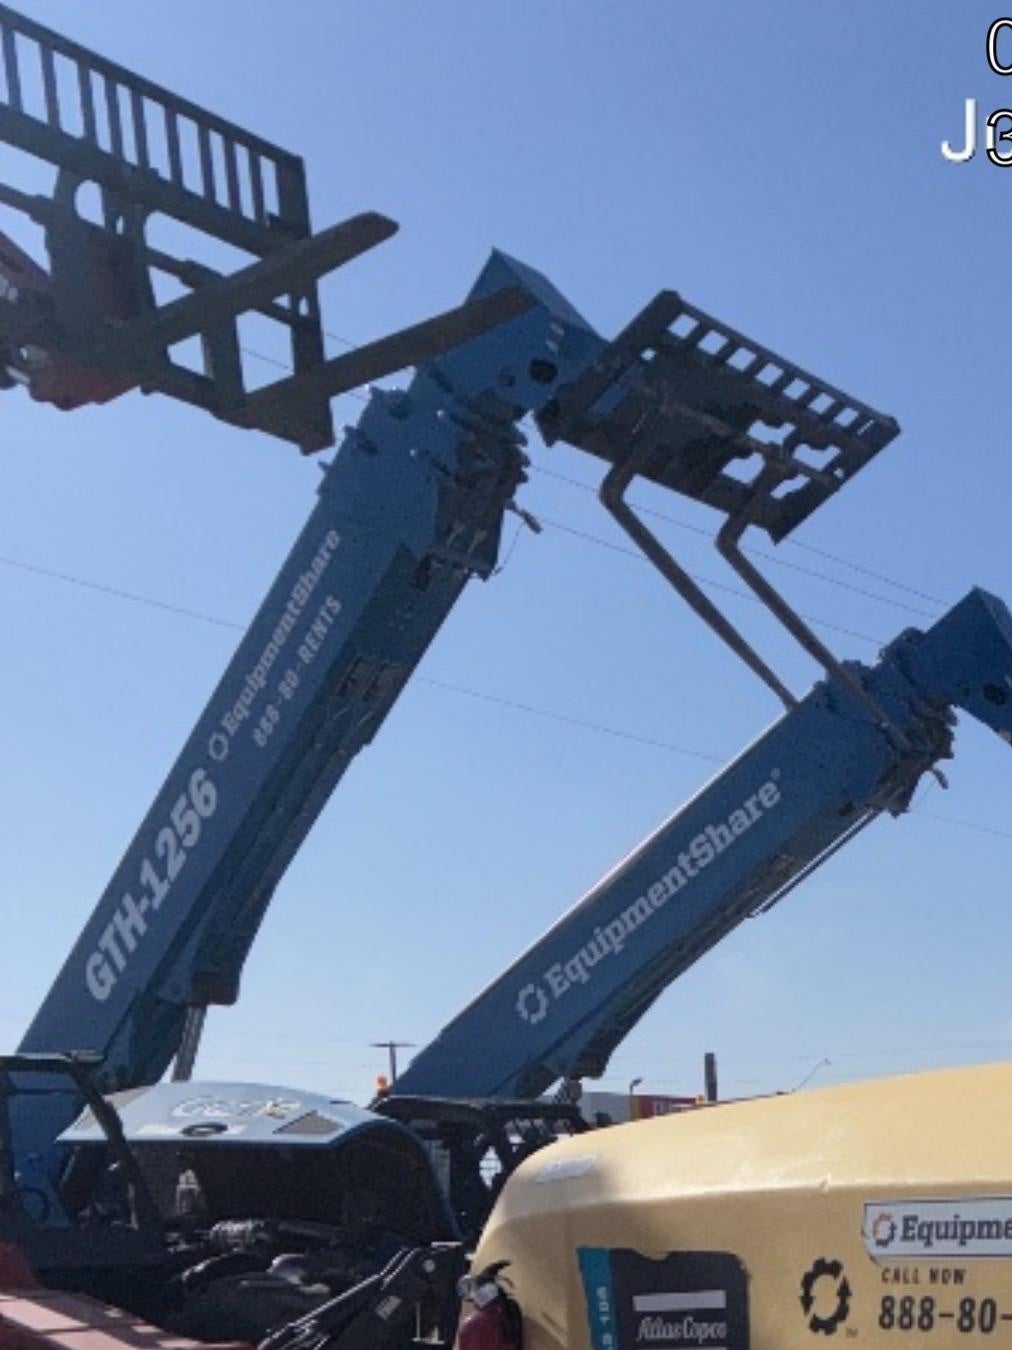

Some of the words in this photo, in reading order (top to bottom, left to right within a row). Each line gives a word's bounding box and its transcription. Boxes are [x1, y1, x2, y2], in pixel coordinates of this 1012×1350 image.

[221, 529, 341, 734] EquipmentShare
[84, 767, 219, 1001] GTH-1256
[543, 780, 782, 1000] EquipmentShare
[881, 1266, 921, 1286] CALL
[929, 1267, 968, 1286] NOW
